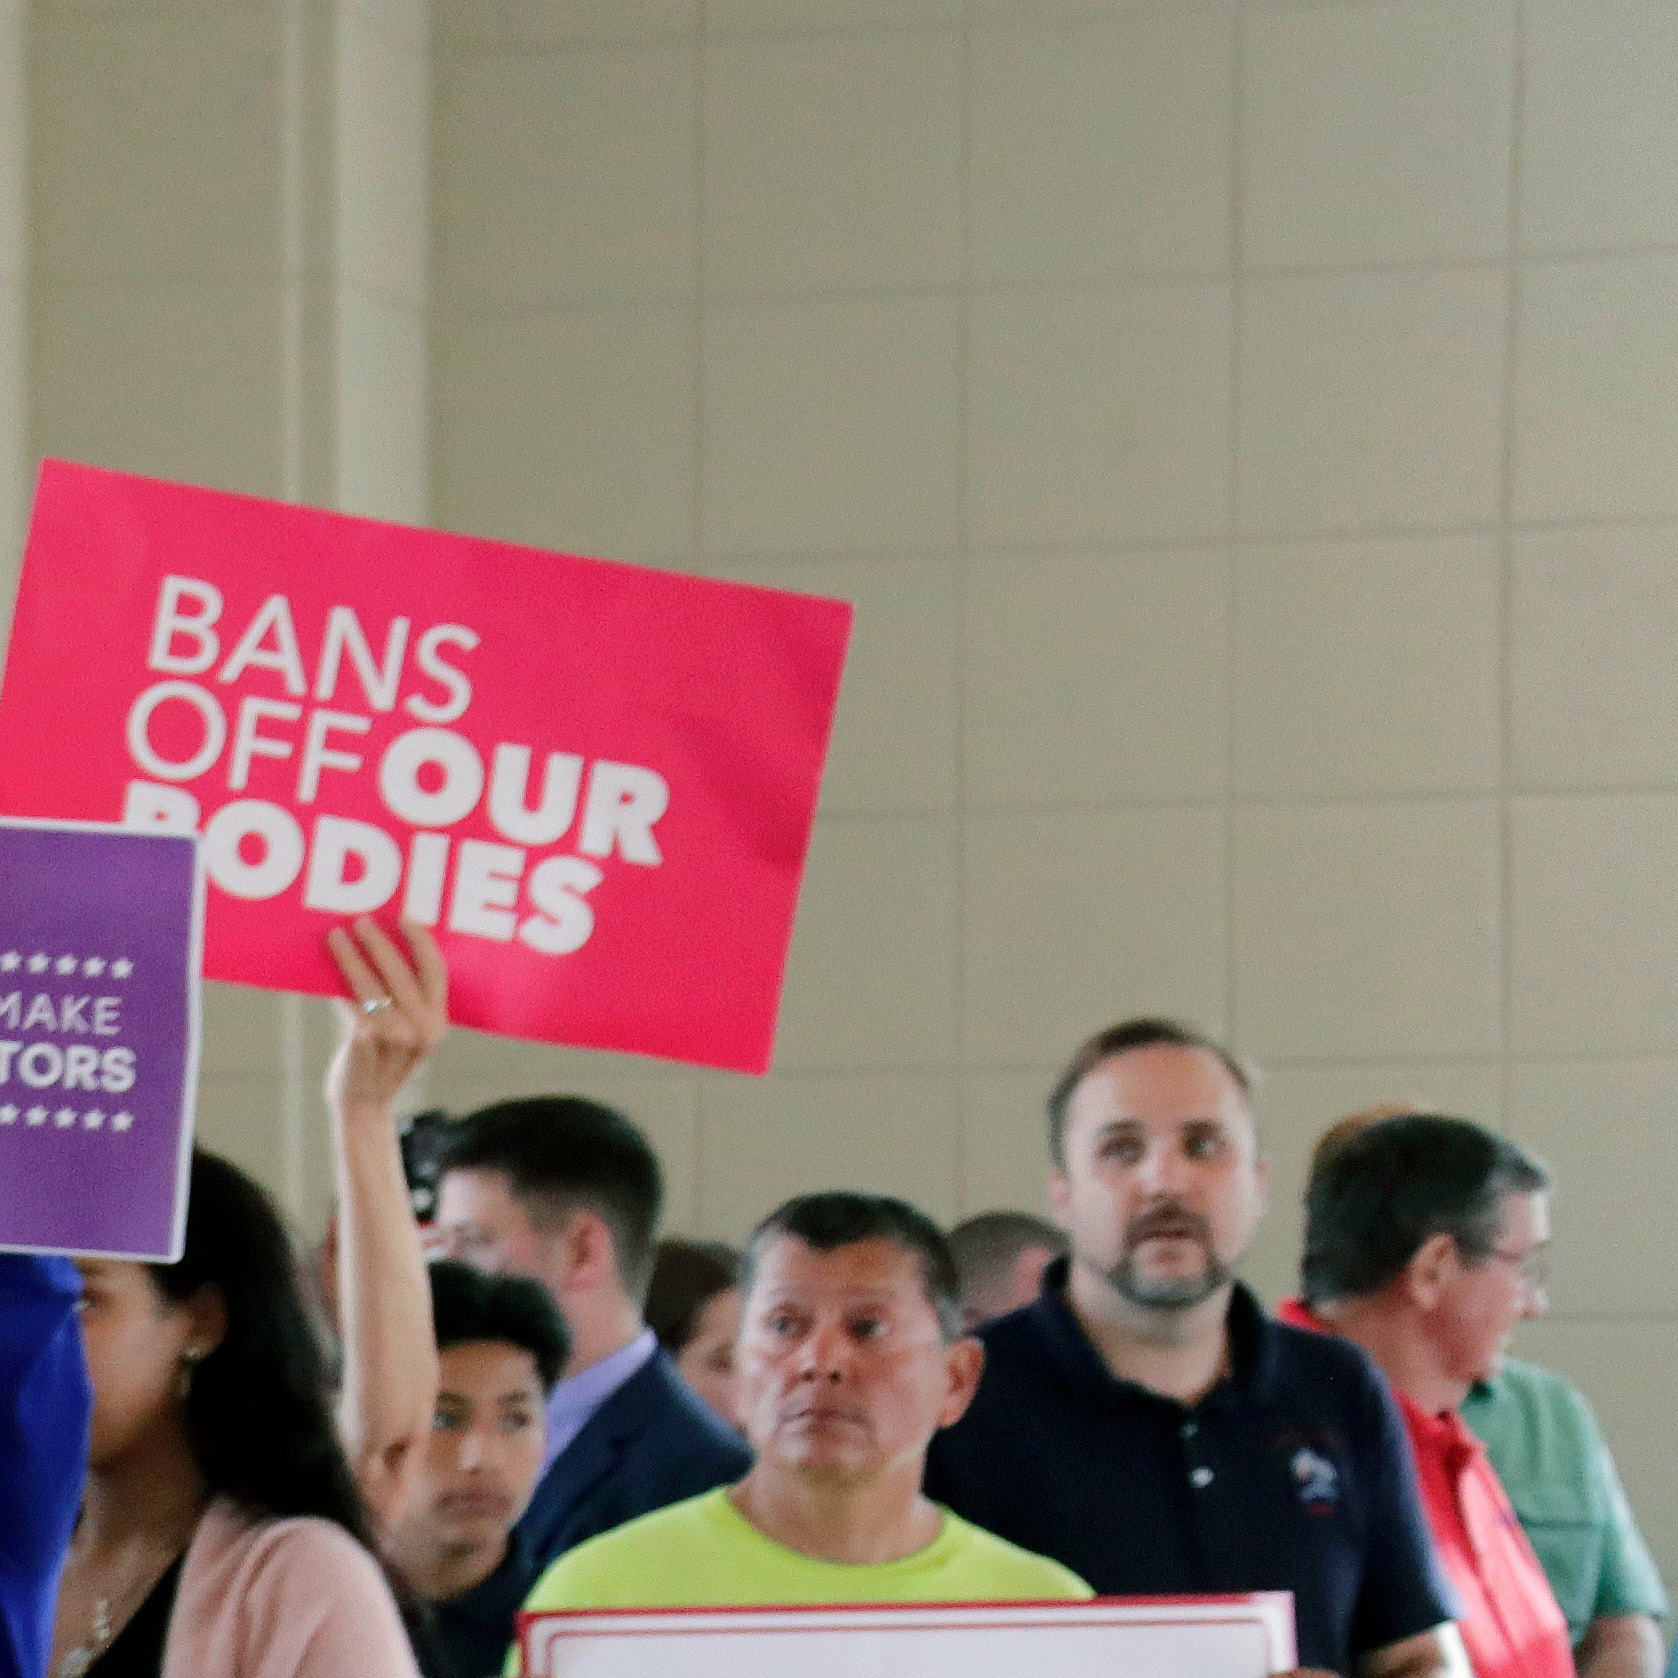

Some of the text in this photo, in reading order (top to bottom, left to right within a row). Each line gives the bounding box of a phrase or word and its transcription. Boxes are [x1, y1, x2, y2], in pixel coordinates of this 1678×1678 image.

[148, 573, 482, 723] BANS
[126, 679, 671, 867] OFF OUR
